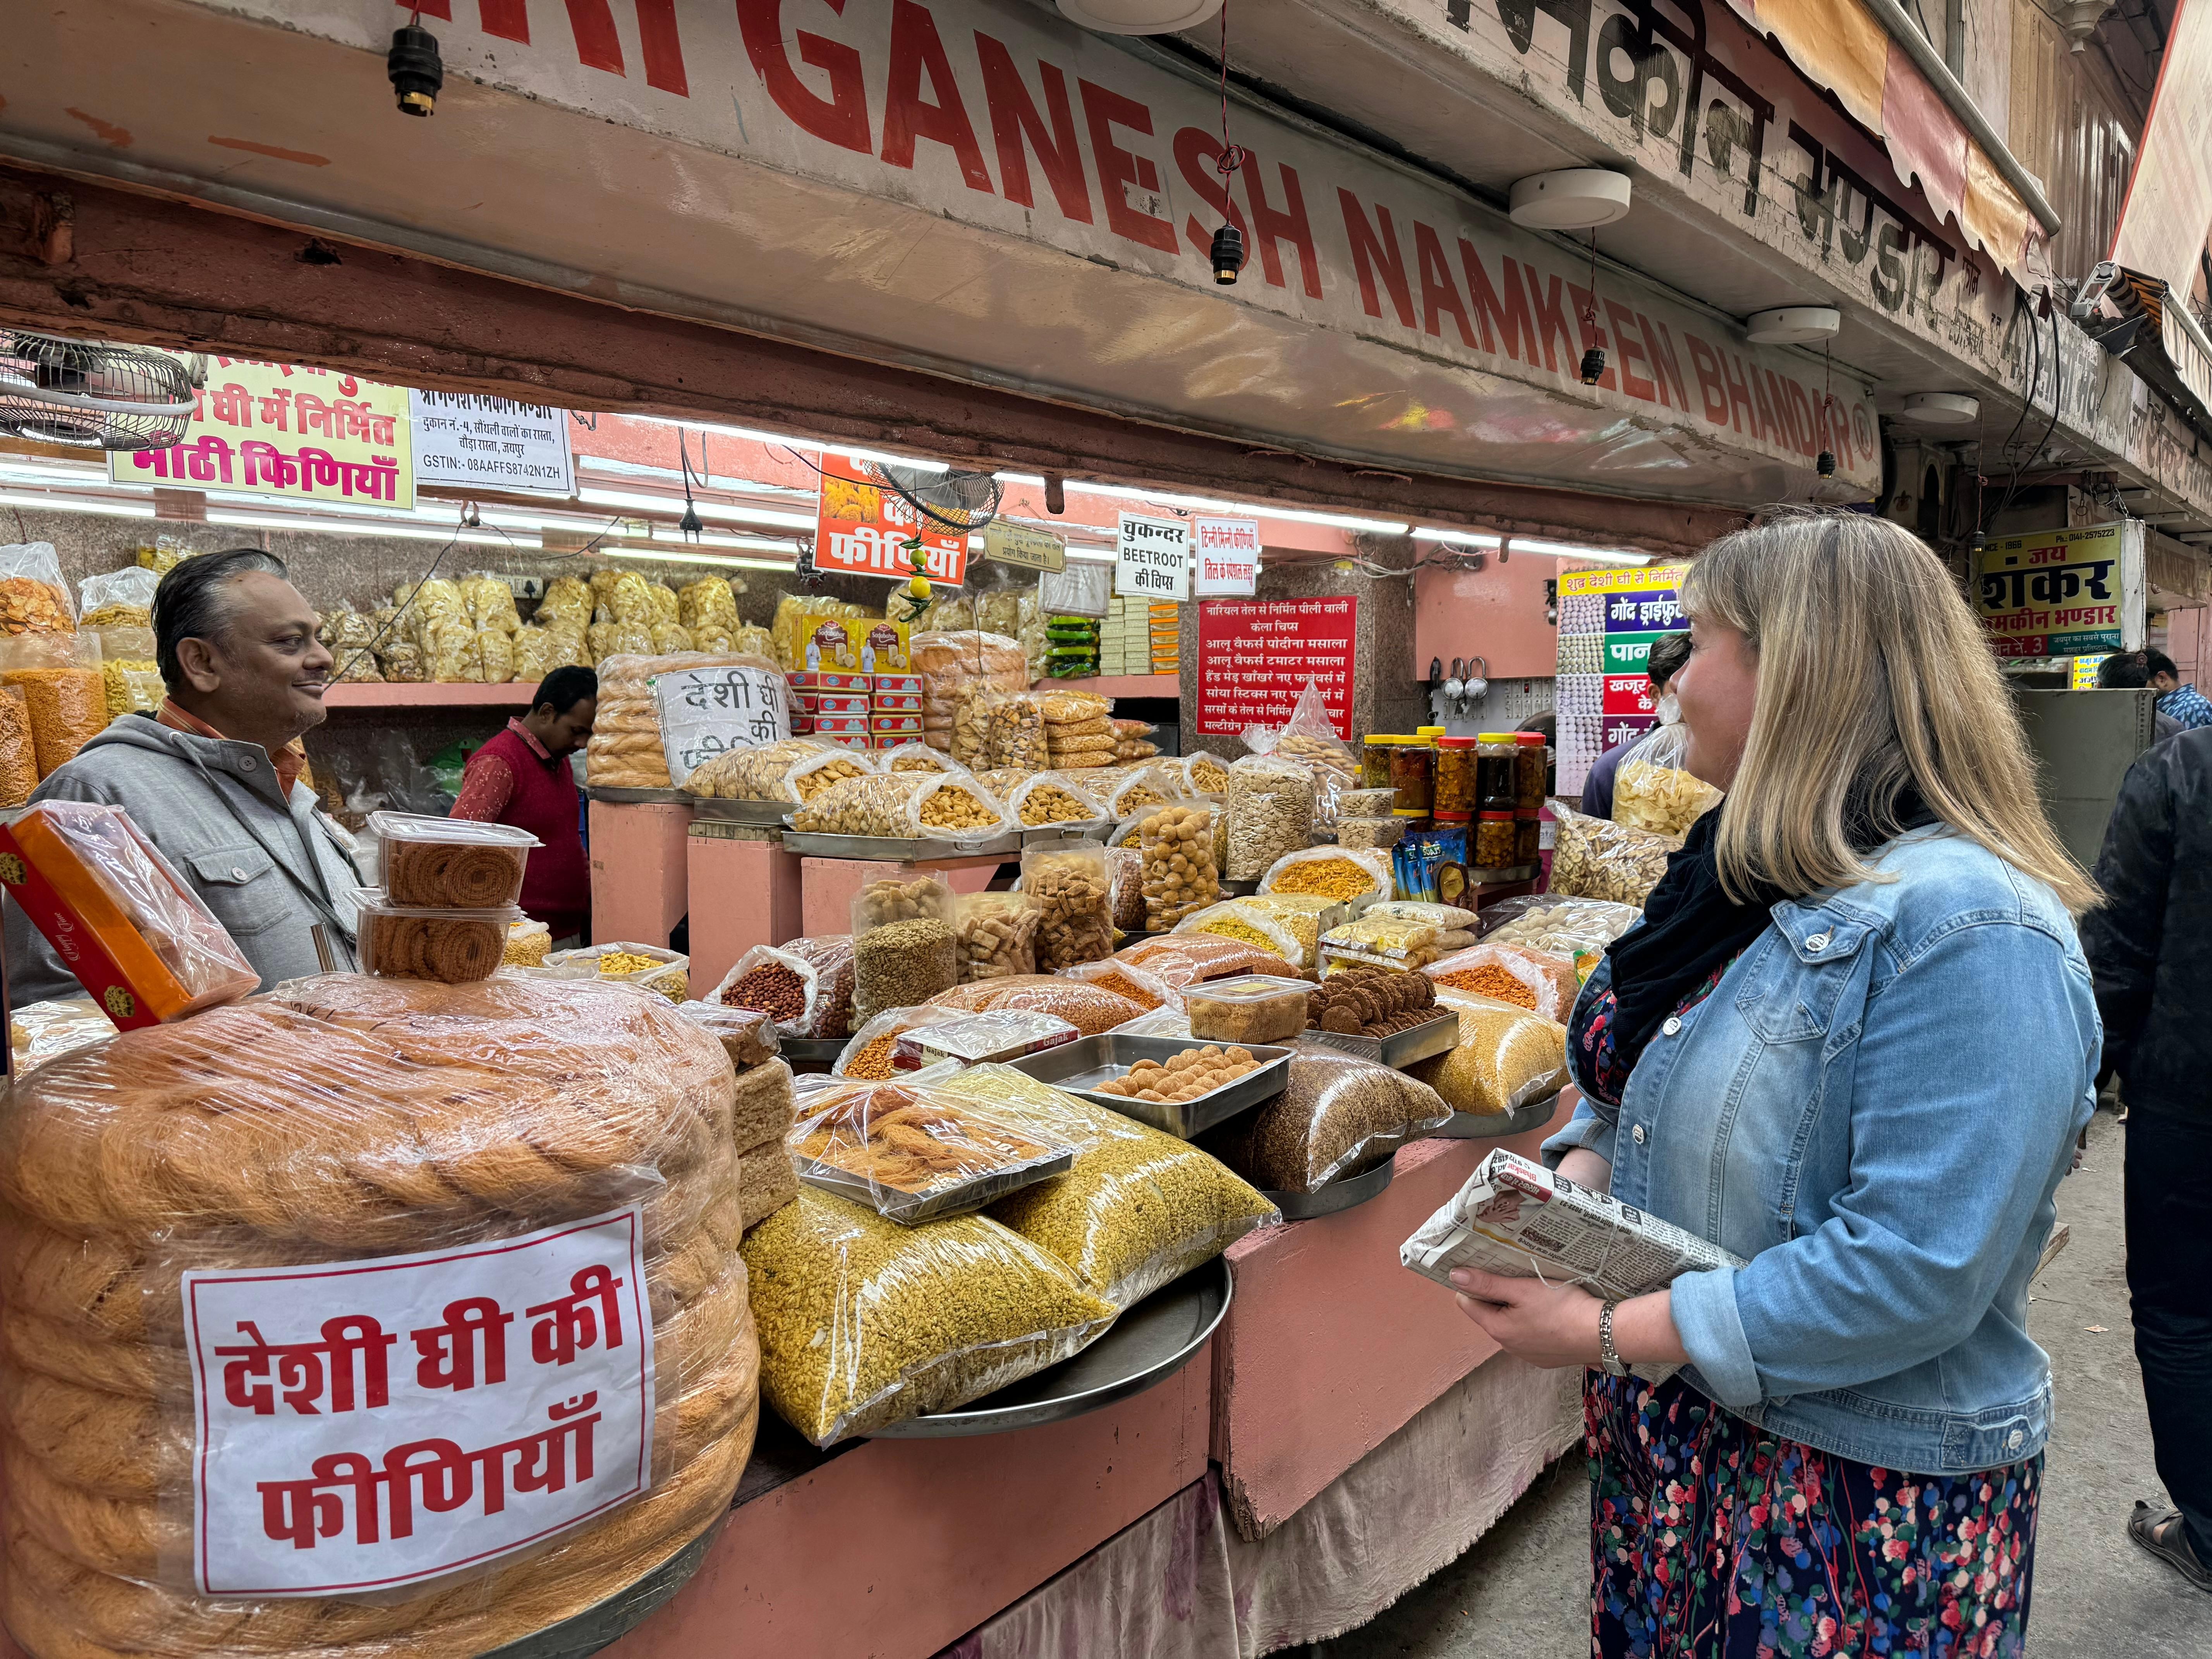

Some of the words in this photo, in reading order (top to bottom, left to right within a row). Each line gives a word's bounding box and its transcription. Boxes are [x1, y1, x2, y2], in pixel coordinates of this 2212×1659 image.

[1446, 0, 1775, 217] मकीन
[736, 0, 1323, 301] GANESH
[1336, 186, 1690, 413] NAMKEEN
[1685, 331, 1854, 471] BHANDAR
[210, 383, 254, 428] घी
[258, 388, 292, 432] में
[294, 393, 396, 447] निर्मित
[422, 416, 447, 432] दुकान
[520, 428, 532, 439] का
[501, 442, 525, 458] जयपुर
[1123, 520, 1186, 544] चुकन्दर
[2069, 528, 2115, 542] 0141-2575223
[1124, 547, 1184, 568] BEETROOT
[2027, 544, 2068, 565] जय
[1205, 557, 1219, 580] तिल
[1135, 568, 1150, 587] की
[1151, 570, 1175, 591] चिप्स
[1589, 572, 1613, 587] देशी
[1616, 571, 1631, 585] घी
[1635, 570, 1645, 584] से
[1649, 568, 1684, 583] निर्मित
[1983, 555, 2115, 610] शंकर
[1206, 605, 1239, 615] नारियल
[1241, 603, 1257, 615] तेल
[1259, 603, 1267, 615] से
[1269, 603, 1297, 615] निर्मित
[1298, 601, 1322, 615] पीली
[1324, 600, 1349, 613] वाली
[1611, 596, 1637, 620] गोंद
[2054, 605, 2117, 627] भण्डार
[817, 628, 845, 639] Sadabahar
[1250, 620, 1273, 632] केला
[1275, 619, 1299, 631] चिप्स
[872, 631, 896, 642] Sadabahar
[1206, 639, 1233, 652] आलू
[1233, 636, 1264, 649] वैफर्स
[1266, 637, 1305, 649] पोदीना
[1307, 639, 1348, 649] मसाला
[2053, 636, 2071, 645] जयपुर
[2083, 632, 2099, 642] सबसे
[2100, 632, 2120, 642] पुराना
[2032, 637, 2042, 654] 3
[1206, 656, 1233, 668] आलू
[1234, 653, 1264, 666] वैफर्स
[1266, 656, 1304, 666] टमाटर
[1306, 656, 1346, 666] मसाला
[1205, 670, 1221, 683] हैंड
[1277, 673, 1292, 685] नए
[1335, 671, 1346, 684] में
[681, 670, 750, 710] देशी
[1205, 686, 1231, 697] सोया
[1270, 690, 1288, 702] नए
[1334, 689, 1345, 701] में
[1609, 679, 1648, 694] खजूर
[1204, 703, 1226, 714] सरसों
[1228, 703, 1238, 714] के
[1240, 703, 1254, 715] तेल
[1256, 704, 1264, 715] से
[1266, 704, 1292, 716] निर्मित
[1638, 694, 1652, 709] के
[749, 710, 778, 742] की
[1042, 1032, 1069, 1047] Gajak
[926, 1045, 945, 1058] Gajak
[1507, 1163, 1536, 1181] Bhaskar
[1559, 1200, 1583, 1213] 2022-23
[214, 1314, 397, 1415] देशी
[410, 1297, 514, 1393] घी
[525, 1264, 623, 1367] की
[256, 1390, 603, 1550] फीणियाँ
